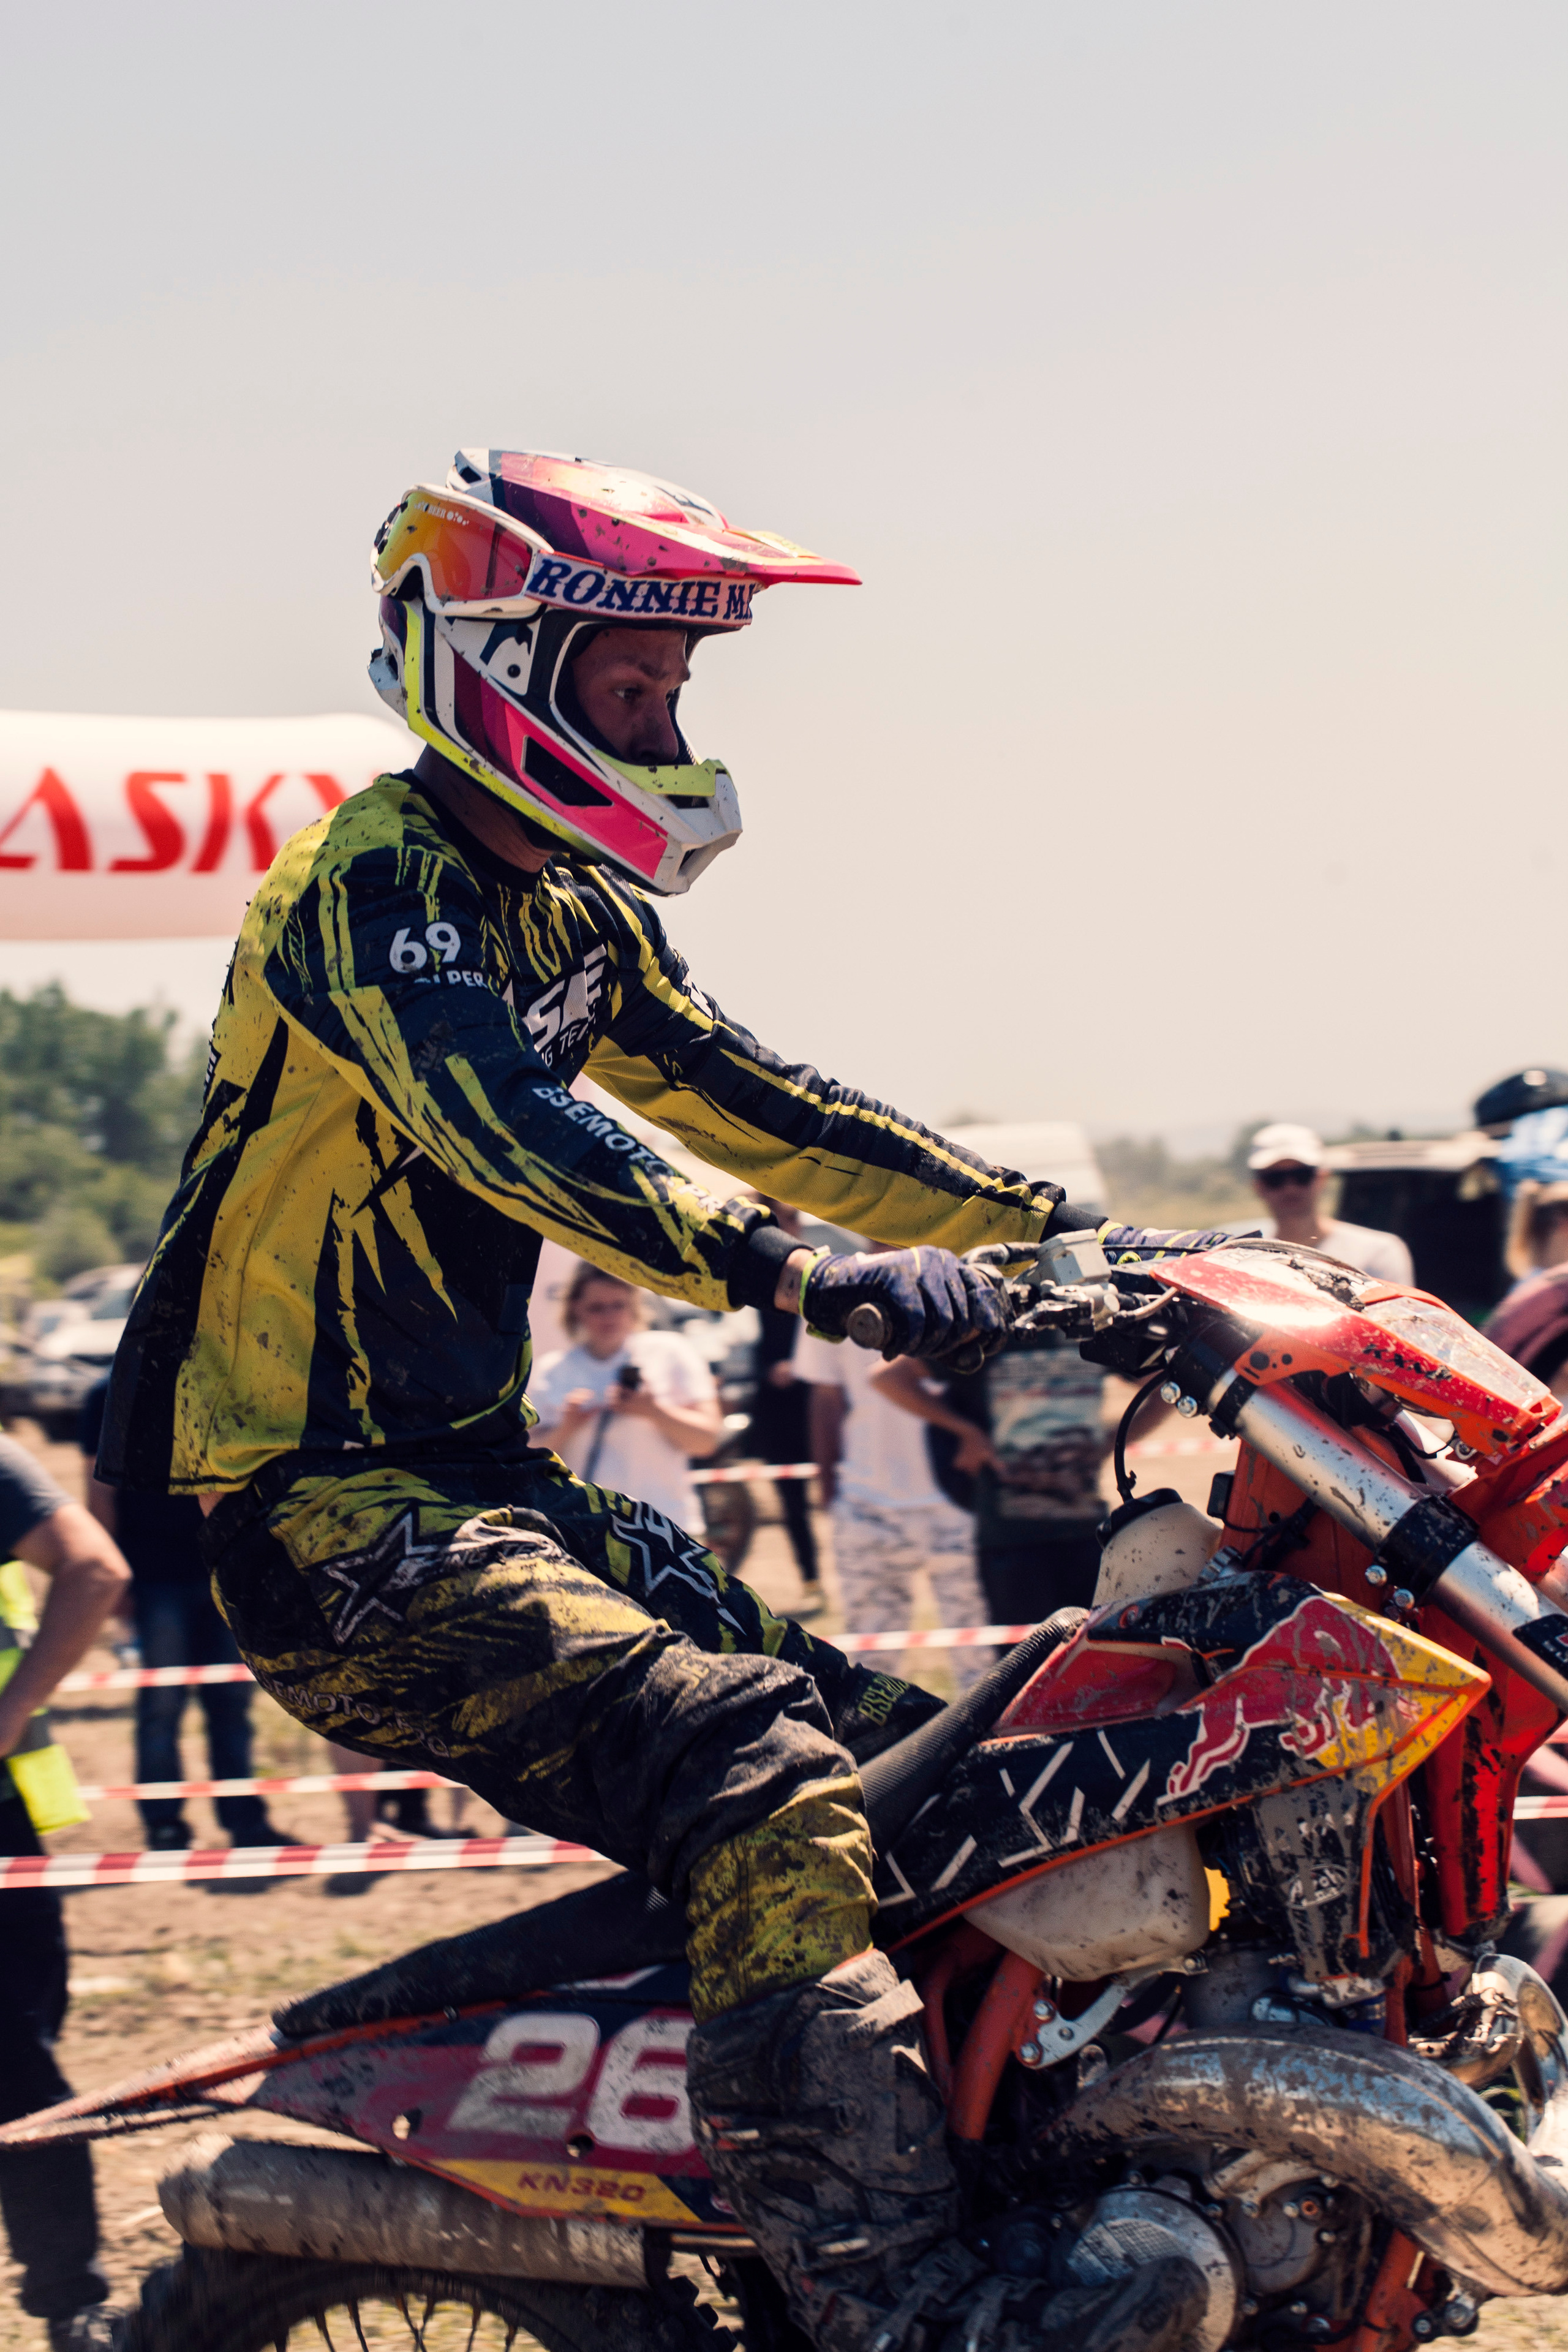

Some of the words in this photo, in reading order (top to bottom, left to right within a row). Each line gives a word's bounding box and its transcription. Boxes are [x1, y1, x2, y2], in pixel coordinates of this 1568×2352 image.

[526, 558, 721, 618] RONNIE
[390, 922, 461, 974] 69
[446, 2011, 696, 2154] 26
